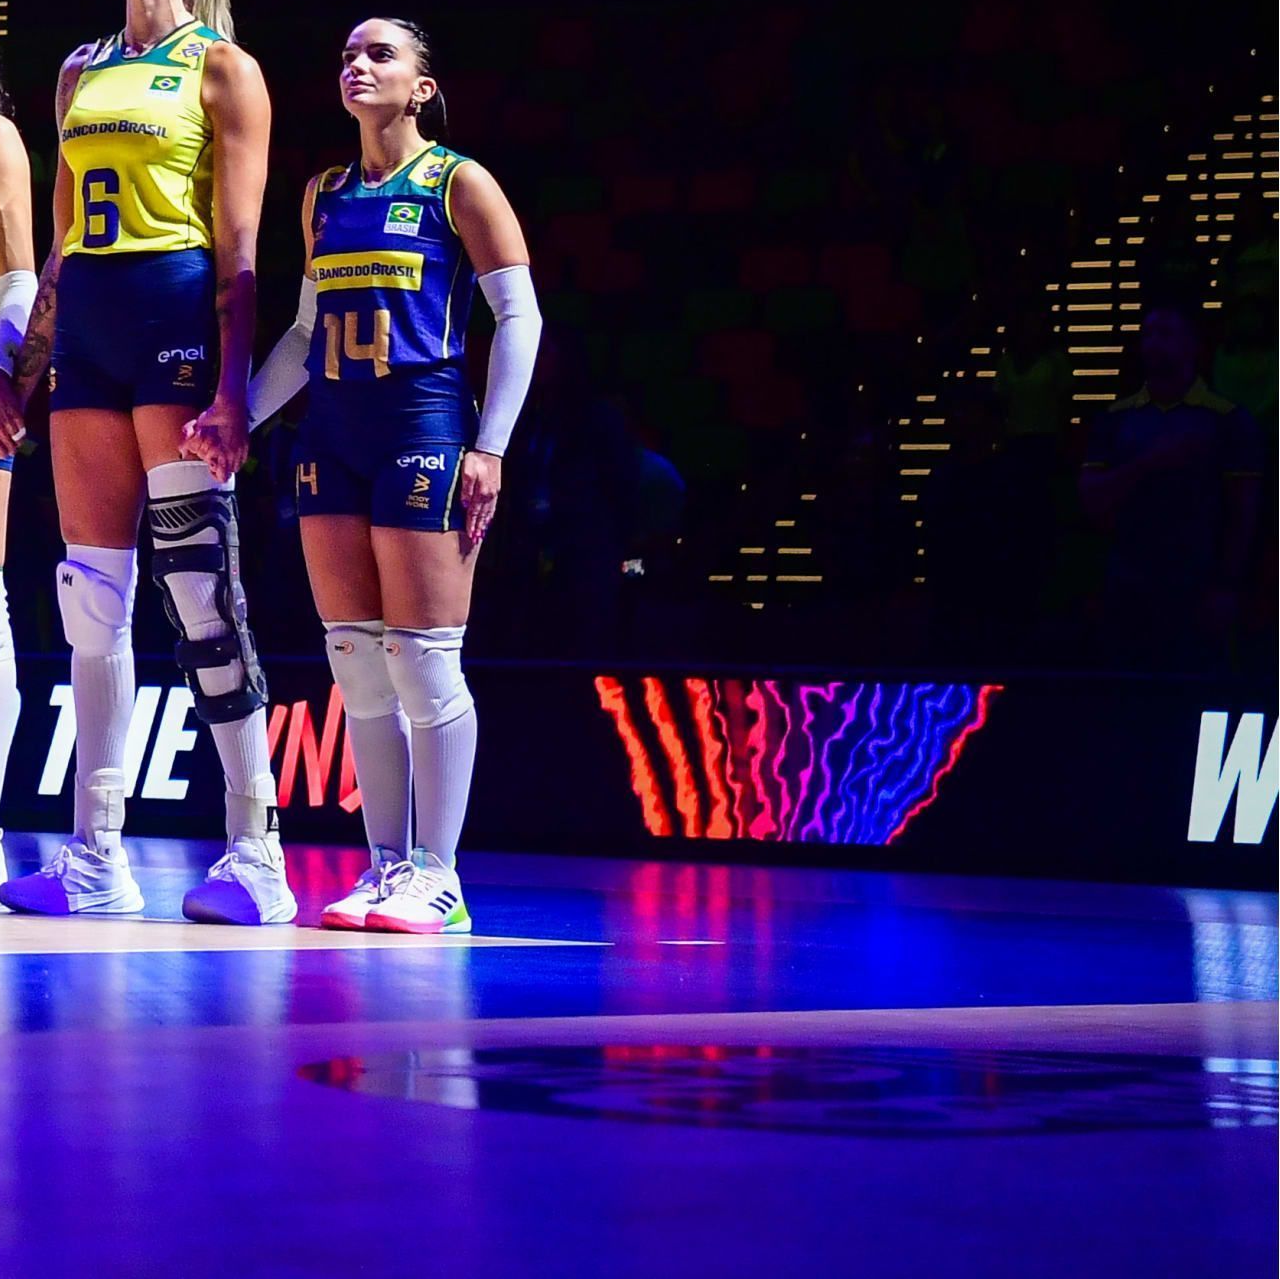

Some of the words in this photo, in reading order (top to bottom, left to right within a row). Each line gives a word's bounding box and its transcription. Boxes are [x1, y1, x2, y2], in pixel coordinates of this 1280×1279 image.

[99, 123, 117, 133] DO
[117, 119, 169, 139] BRASIL
[82, 167, 120, 248] 6
[385, 223, 417, 235] BRASIL
[319, 267, 354, 279] BANCO
[355, 267, 370, 276] DO
[371, 262, 415, 278] BRASIL
[158, 345, 205, 363] enel
[323, 309, 391, 381] 14
[396, 453, 445, 471] enel
[300, 462, 318, 495] 4
